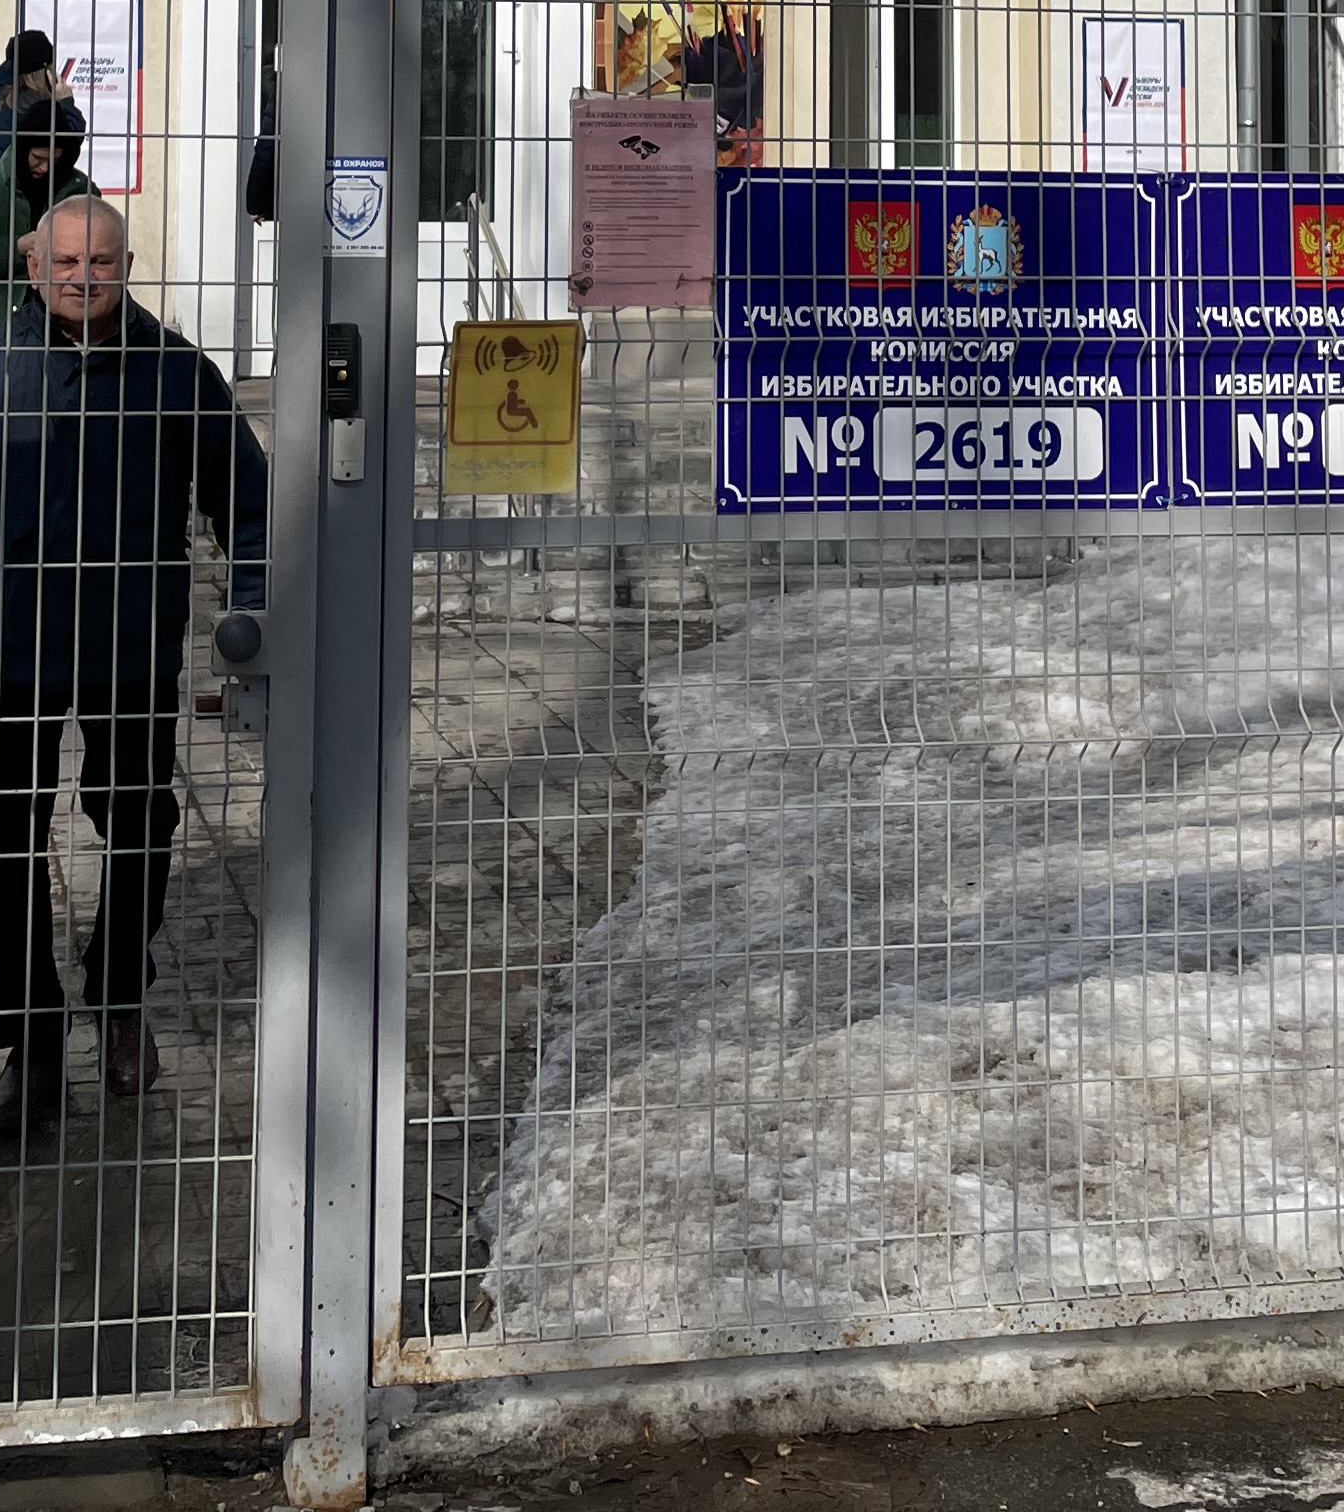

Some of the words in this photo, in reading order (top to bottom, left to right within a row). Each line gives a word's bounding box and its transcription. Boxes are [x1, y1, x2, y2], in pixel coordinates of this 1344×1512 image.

[742, 306, 913, 328] УЧАСТКОВАЯ
[921, 307, 1138, 329] ИЗБИРАТЕЛЬНАЯ
[870, 340, 1015, 362] КОМИССИЯ
[761, 375, 1001, 397] ИЗБИРАТЕЛЬНОГО
[1011, 375, 1123, 397] УЧАСТКА
[783, 416, 865, 474] №
[914, 420, 1062, 470] 2619
[1237, 412, 1314, 469] №
